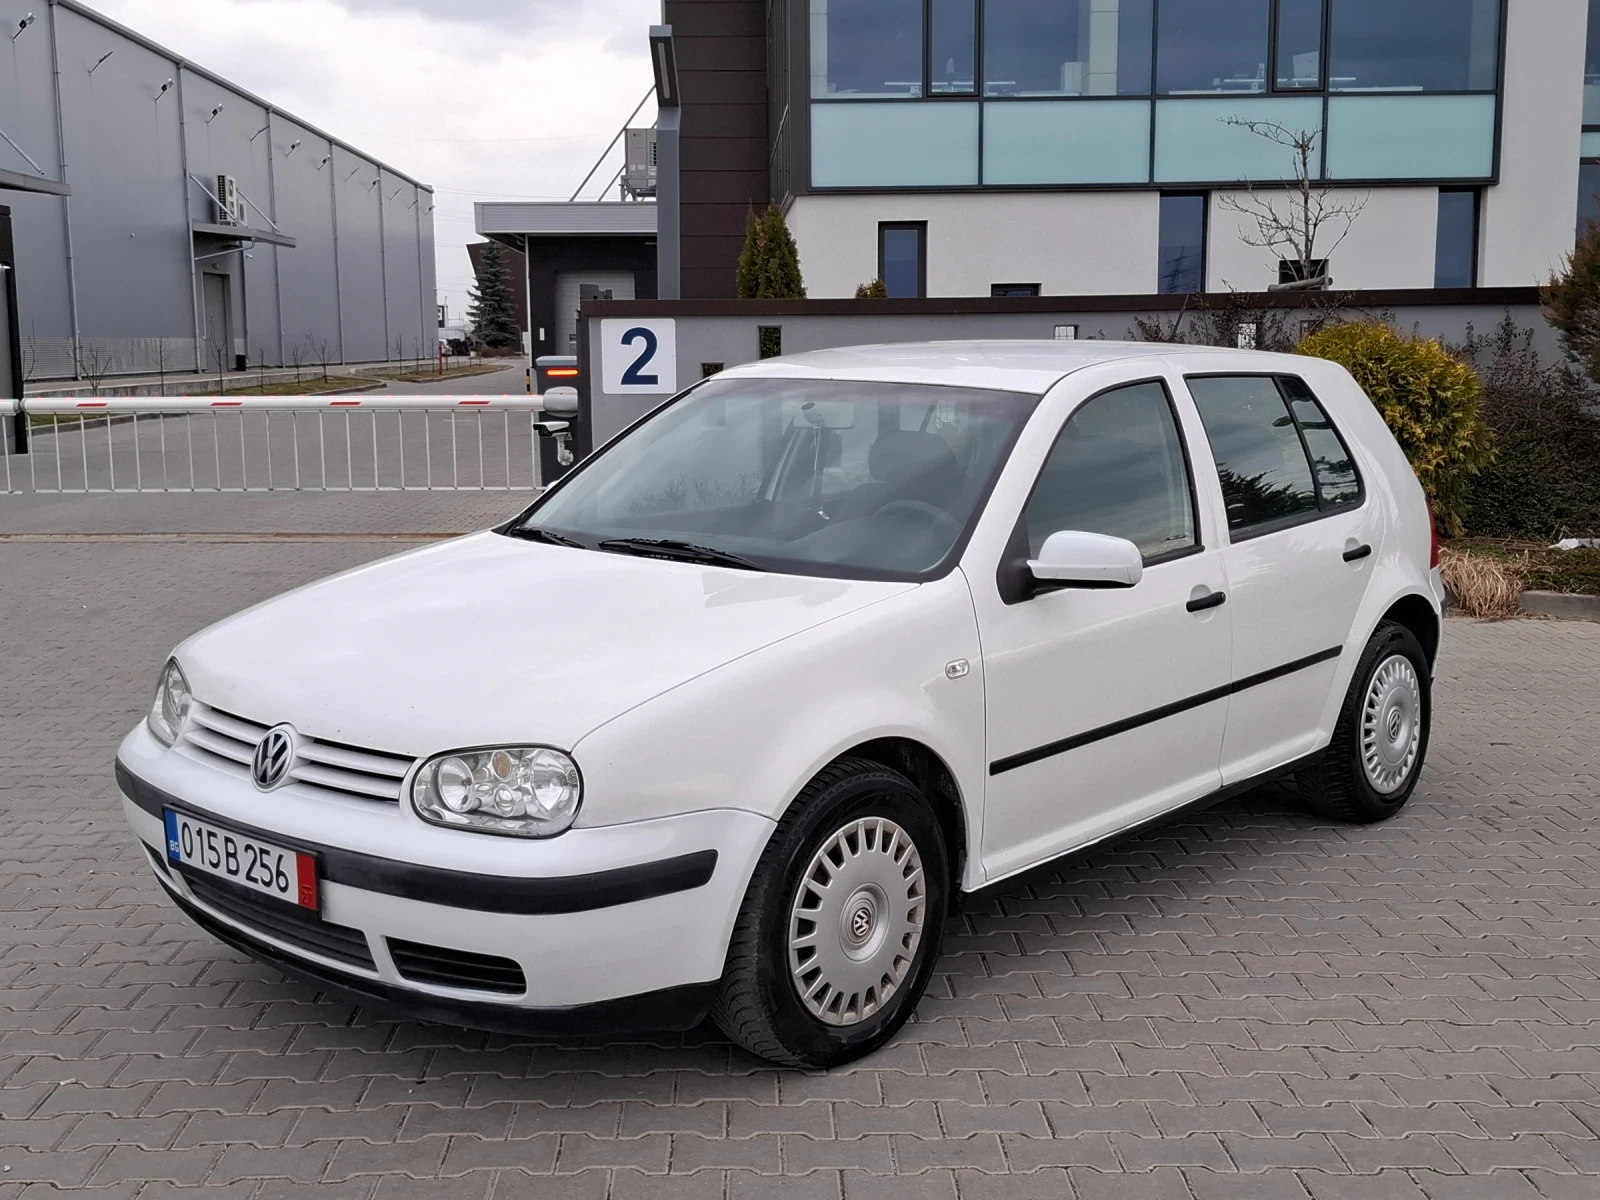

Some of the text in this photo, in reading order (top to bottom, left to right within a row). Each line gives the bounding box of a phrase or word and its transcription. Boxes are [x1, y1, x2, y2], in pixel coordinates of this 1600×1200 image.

[620, 327, 659, 385] 2
[169, 839, 179, 853] BG
[181, 821, 290, 893] 015B256
